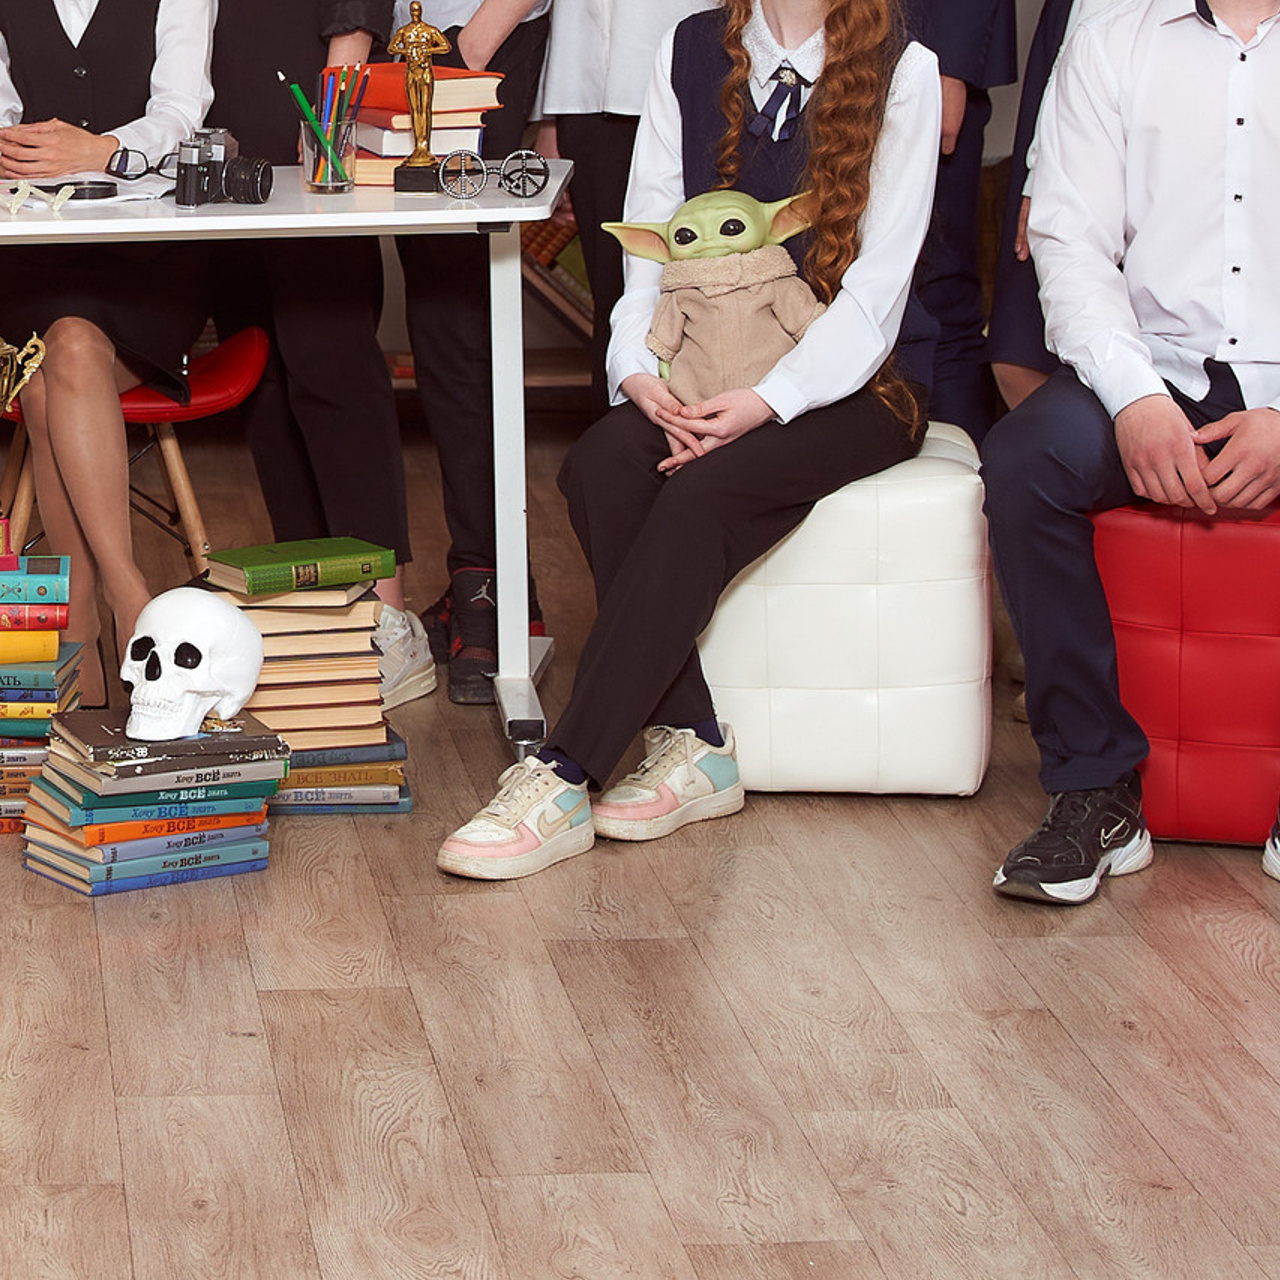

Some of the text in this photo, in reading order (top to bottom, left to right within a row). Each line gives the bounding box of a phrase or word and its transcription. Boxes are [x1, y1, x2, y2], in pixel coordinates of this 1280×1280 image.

[174, 773, 194, 784] Хочу
[195, 769, 220, 784] ВСЁ
[328, 770, 373, 781] ЗНАТЬ
[158, 791, 178, 801] Хочу
[179, 787, 206, 800] ВСЁ
[293, 789, 325, 802] ВСЁ
[131, 807, 155, 819] Хочу
[157, 802, 189, 818] ВСЁ
[142, 823, 165, 835] Хочу
[166, 817, 196, 833] ВСЁ
[165, 838, 183, 849] Хочу
[183, 832, 207, 847] ВСЁ
[161, 859, 179, 869] Хочу
[179, 854, 202, 868] ВСЁ
